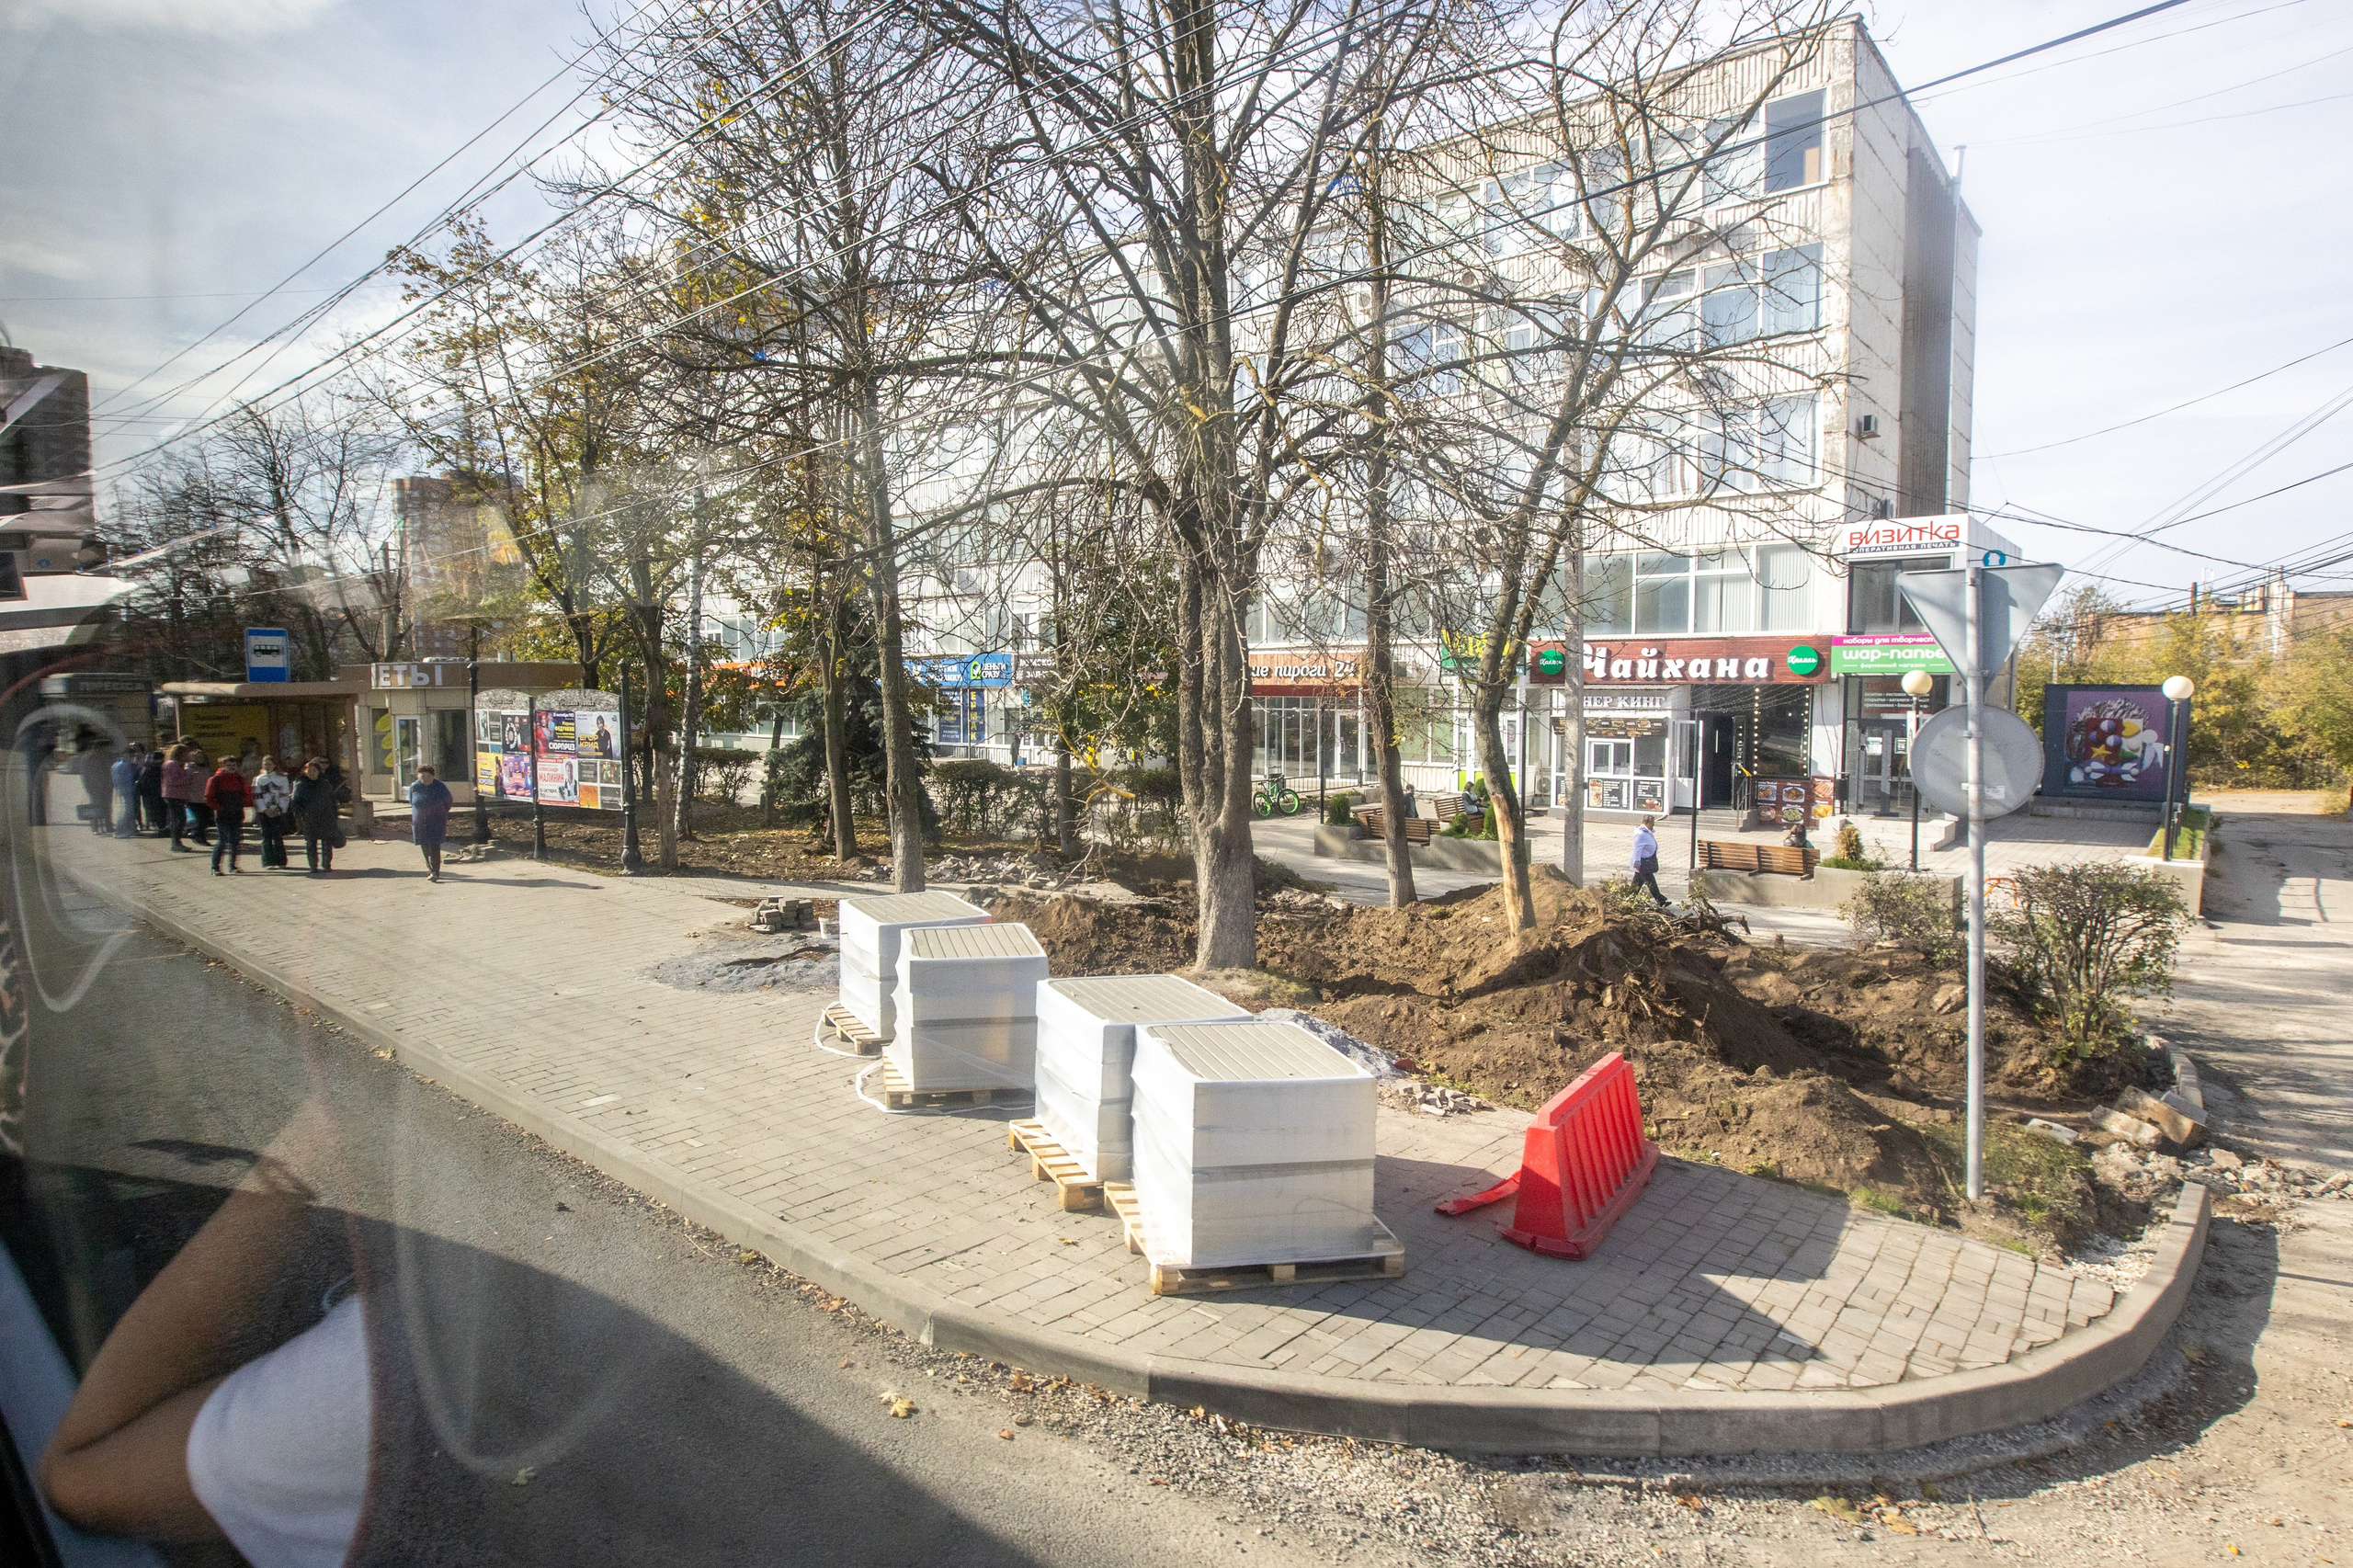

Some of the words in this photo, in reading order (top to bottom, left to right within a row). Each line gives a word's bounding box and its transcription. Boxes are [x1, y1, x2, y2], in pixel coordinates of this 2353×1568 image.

[1920, 541, 1956, 550] ПЕЧАТЬ
[1874, 637, 1890, 645] для
[1892, 635, 1936, 644] творчест
[1842, 648, 1947, 662] шар-папье
[1583, 643, 1769, 678] Чайхана
[982, 663, 1006, 672] ДЕНЬГИ
[982, 670, 1000, 678] СРАЗУ
[1275, 665, 1326, 681] пироги
[1617, 696, 1665, 709] КИНГ
[549, 742, 575, 751] СЮРПРИЗ
[579, 741, 599, 750] КРИД
[539, 772, 564, 783] МАЛИНИН
